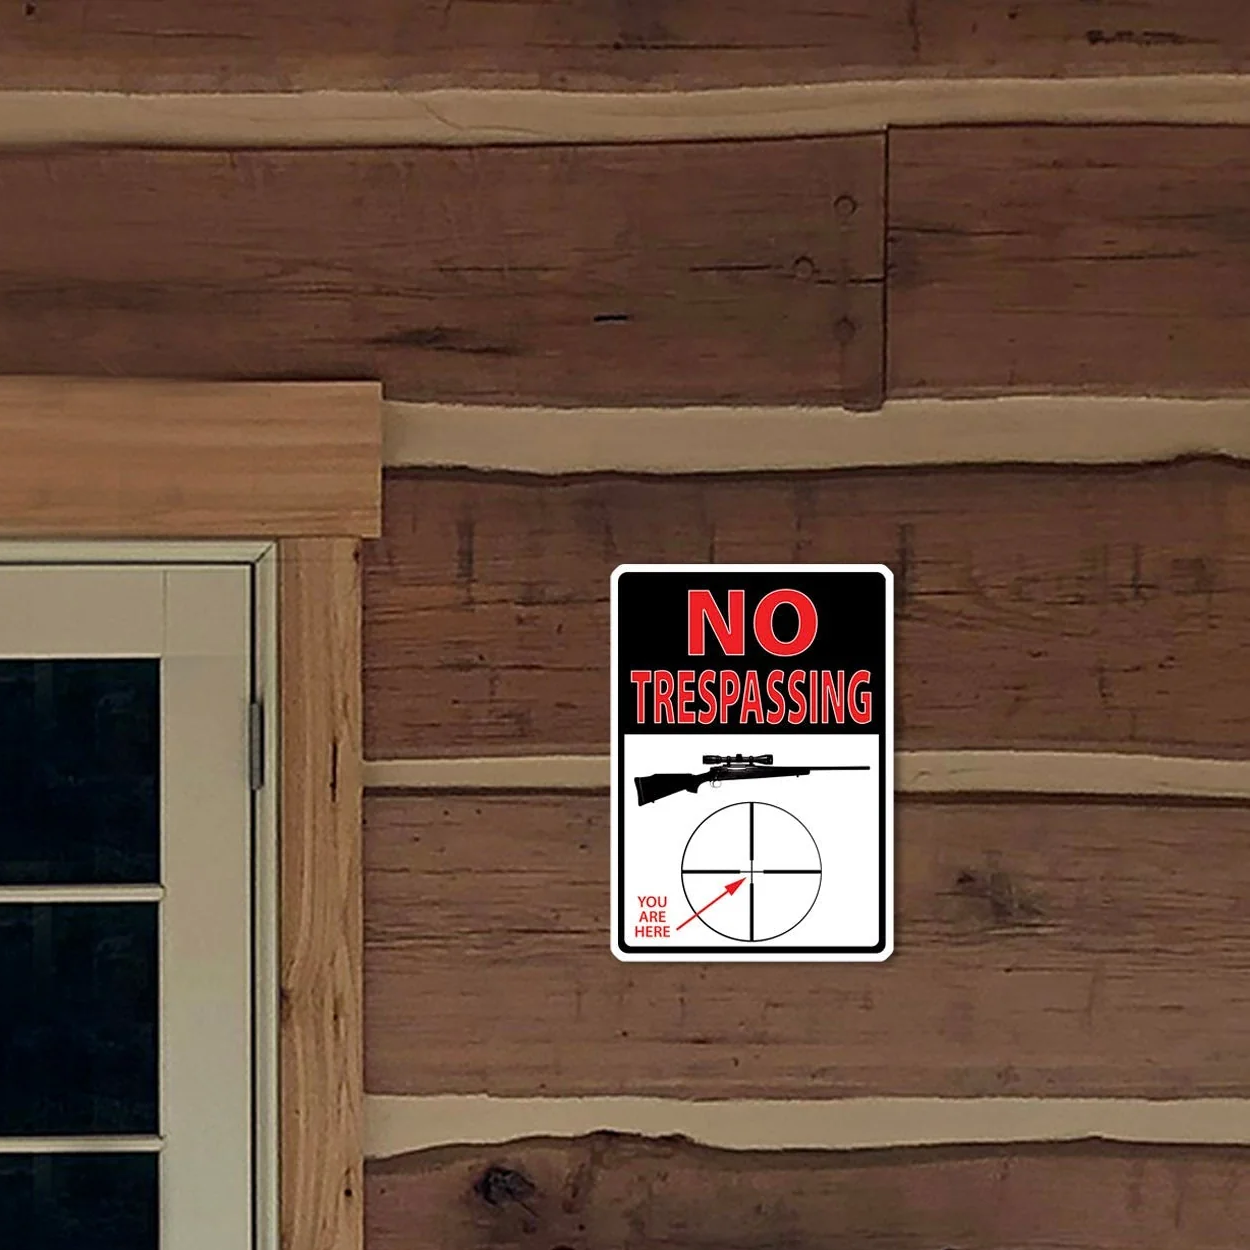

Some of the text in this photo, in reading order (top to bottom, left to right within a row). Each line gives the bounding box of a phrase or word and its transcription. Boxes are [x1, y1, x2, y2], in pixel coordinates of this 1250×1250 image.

[687, 588, 819, 657] NO
[630, 669, 872, 725] TRESPASSING
[637, 896, 668, 908] YOU
[638, 911, 667, 923] ARE
[634, 925, 671, 938] HERE
